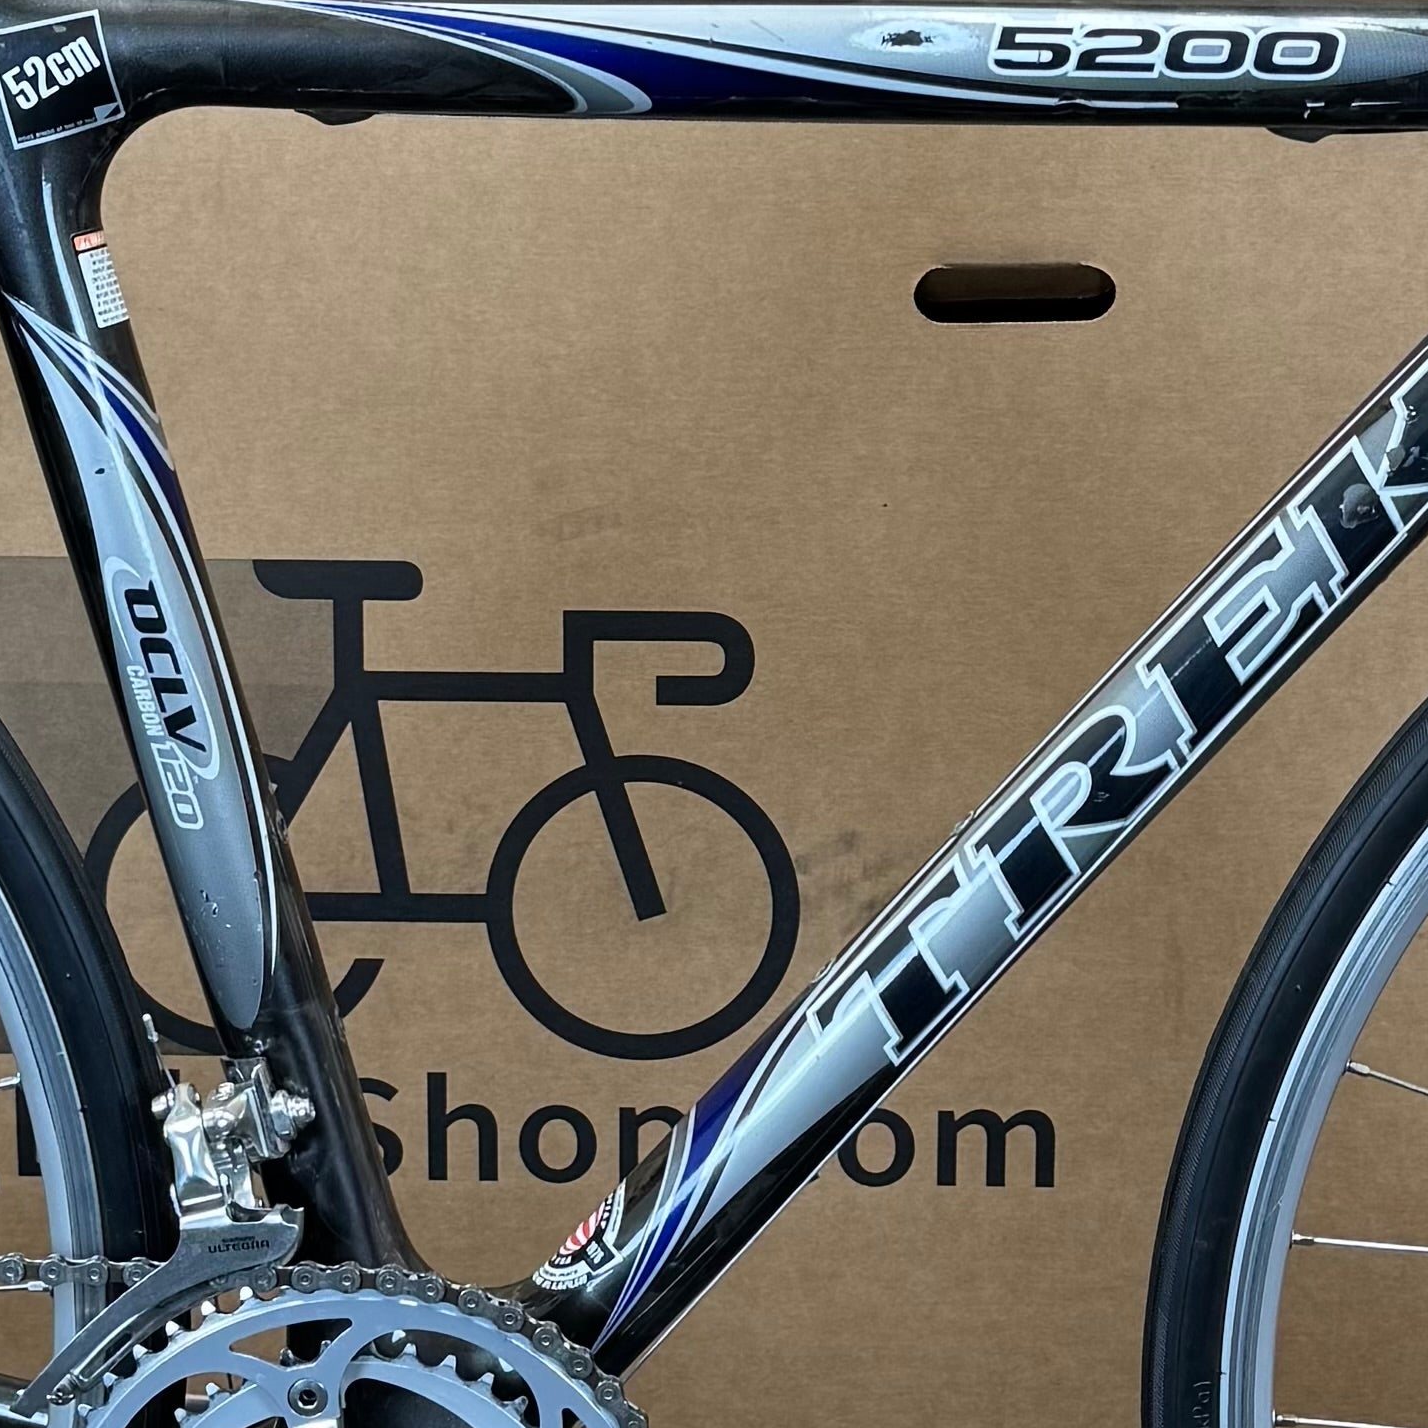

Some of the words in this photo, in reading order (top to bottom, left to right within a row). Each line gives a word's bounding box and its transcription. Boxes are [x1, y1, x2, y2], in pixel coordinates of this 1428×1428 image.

[2, 35, 101, 110] 52cm
[992, 24, 1345, 79] 5200
[126, 665, 164, 736] CARBON
